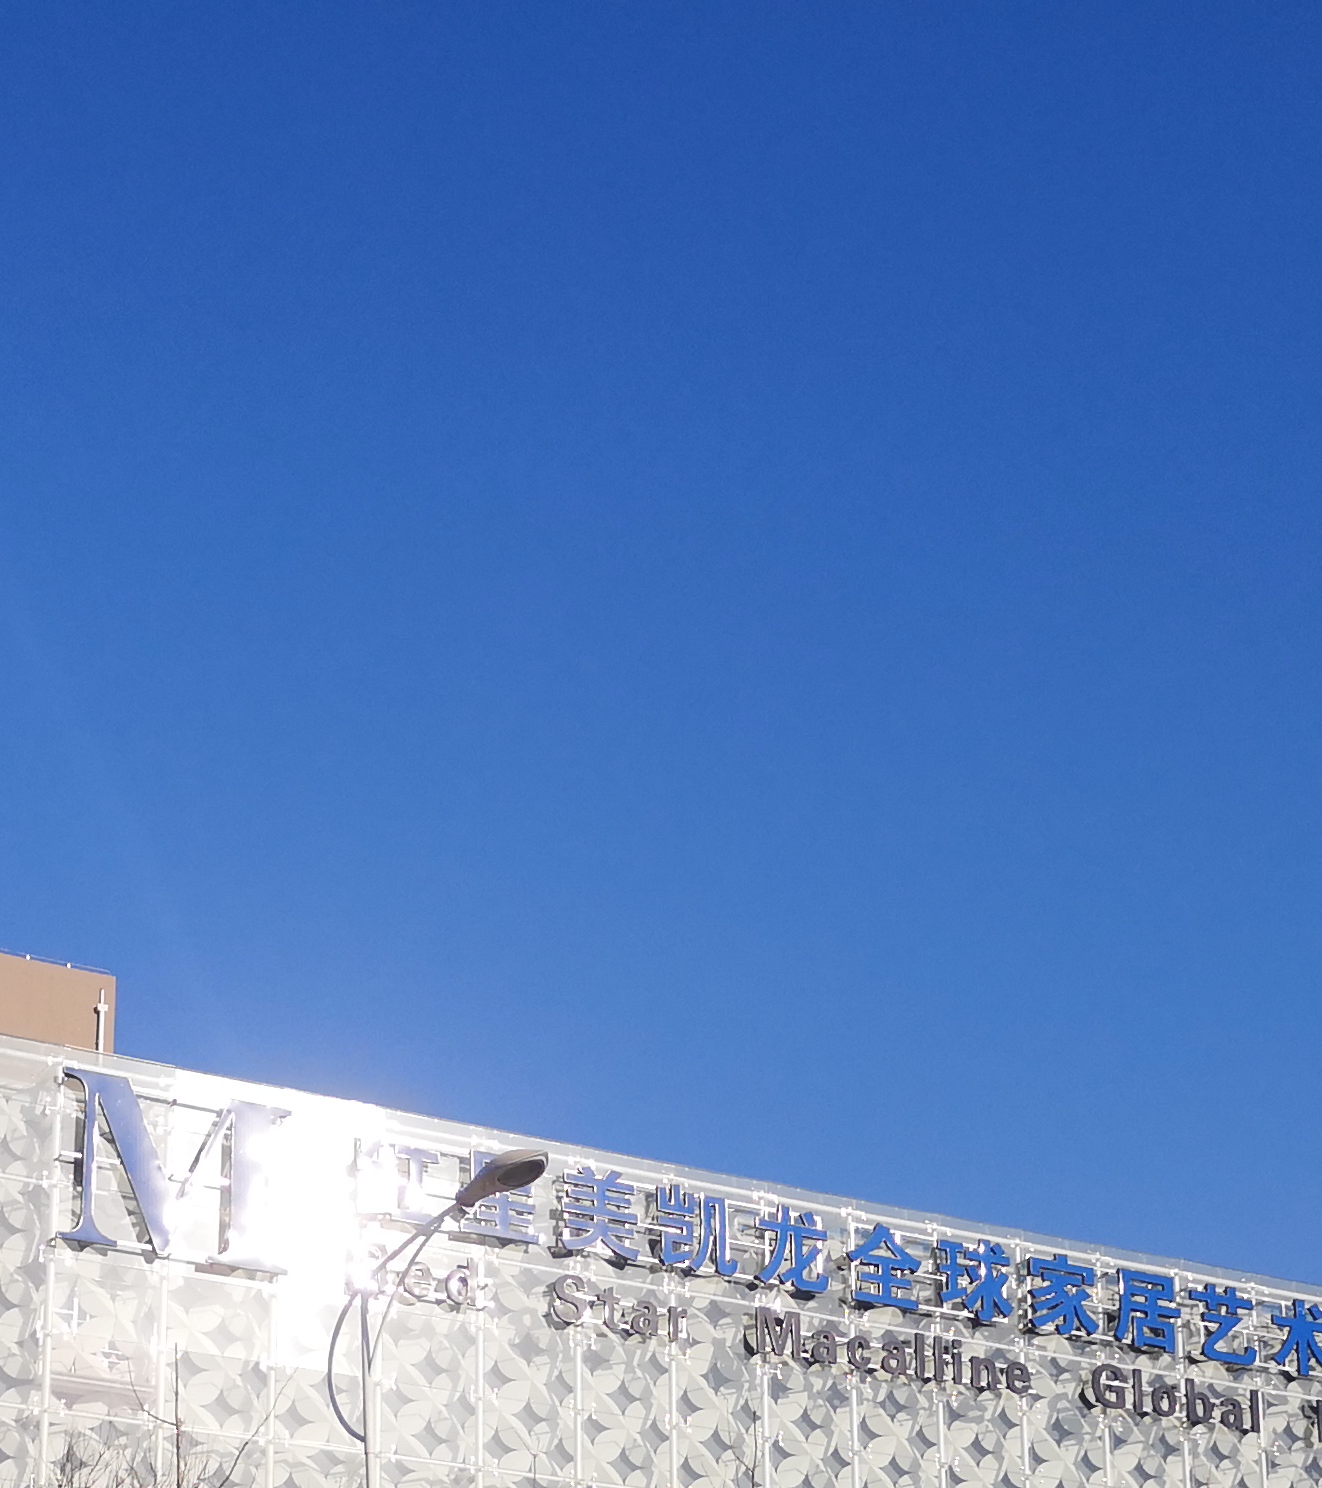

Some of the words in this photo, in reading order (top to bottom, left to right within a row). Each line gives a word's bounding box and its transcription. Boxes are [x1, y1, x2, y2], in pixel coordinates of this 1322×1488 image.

[553, 1274, 688, 1341] Star
[755, 1306, 1032, 1395] Macalline
[1091, 1363, 1261, 1433] Global
